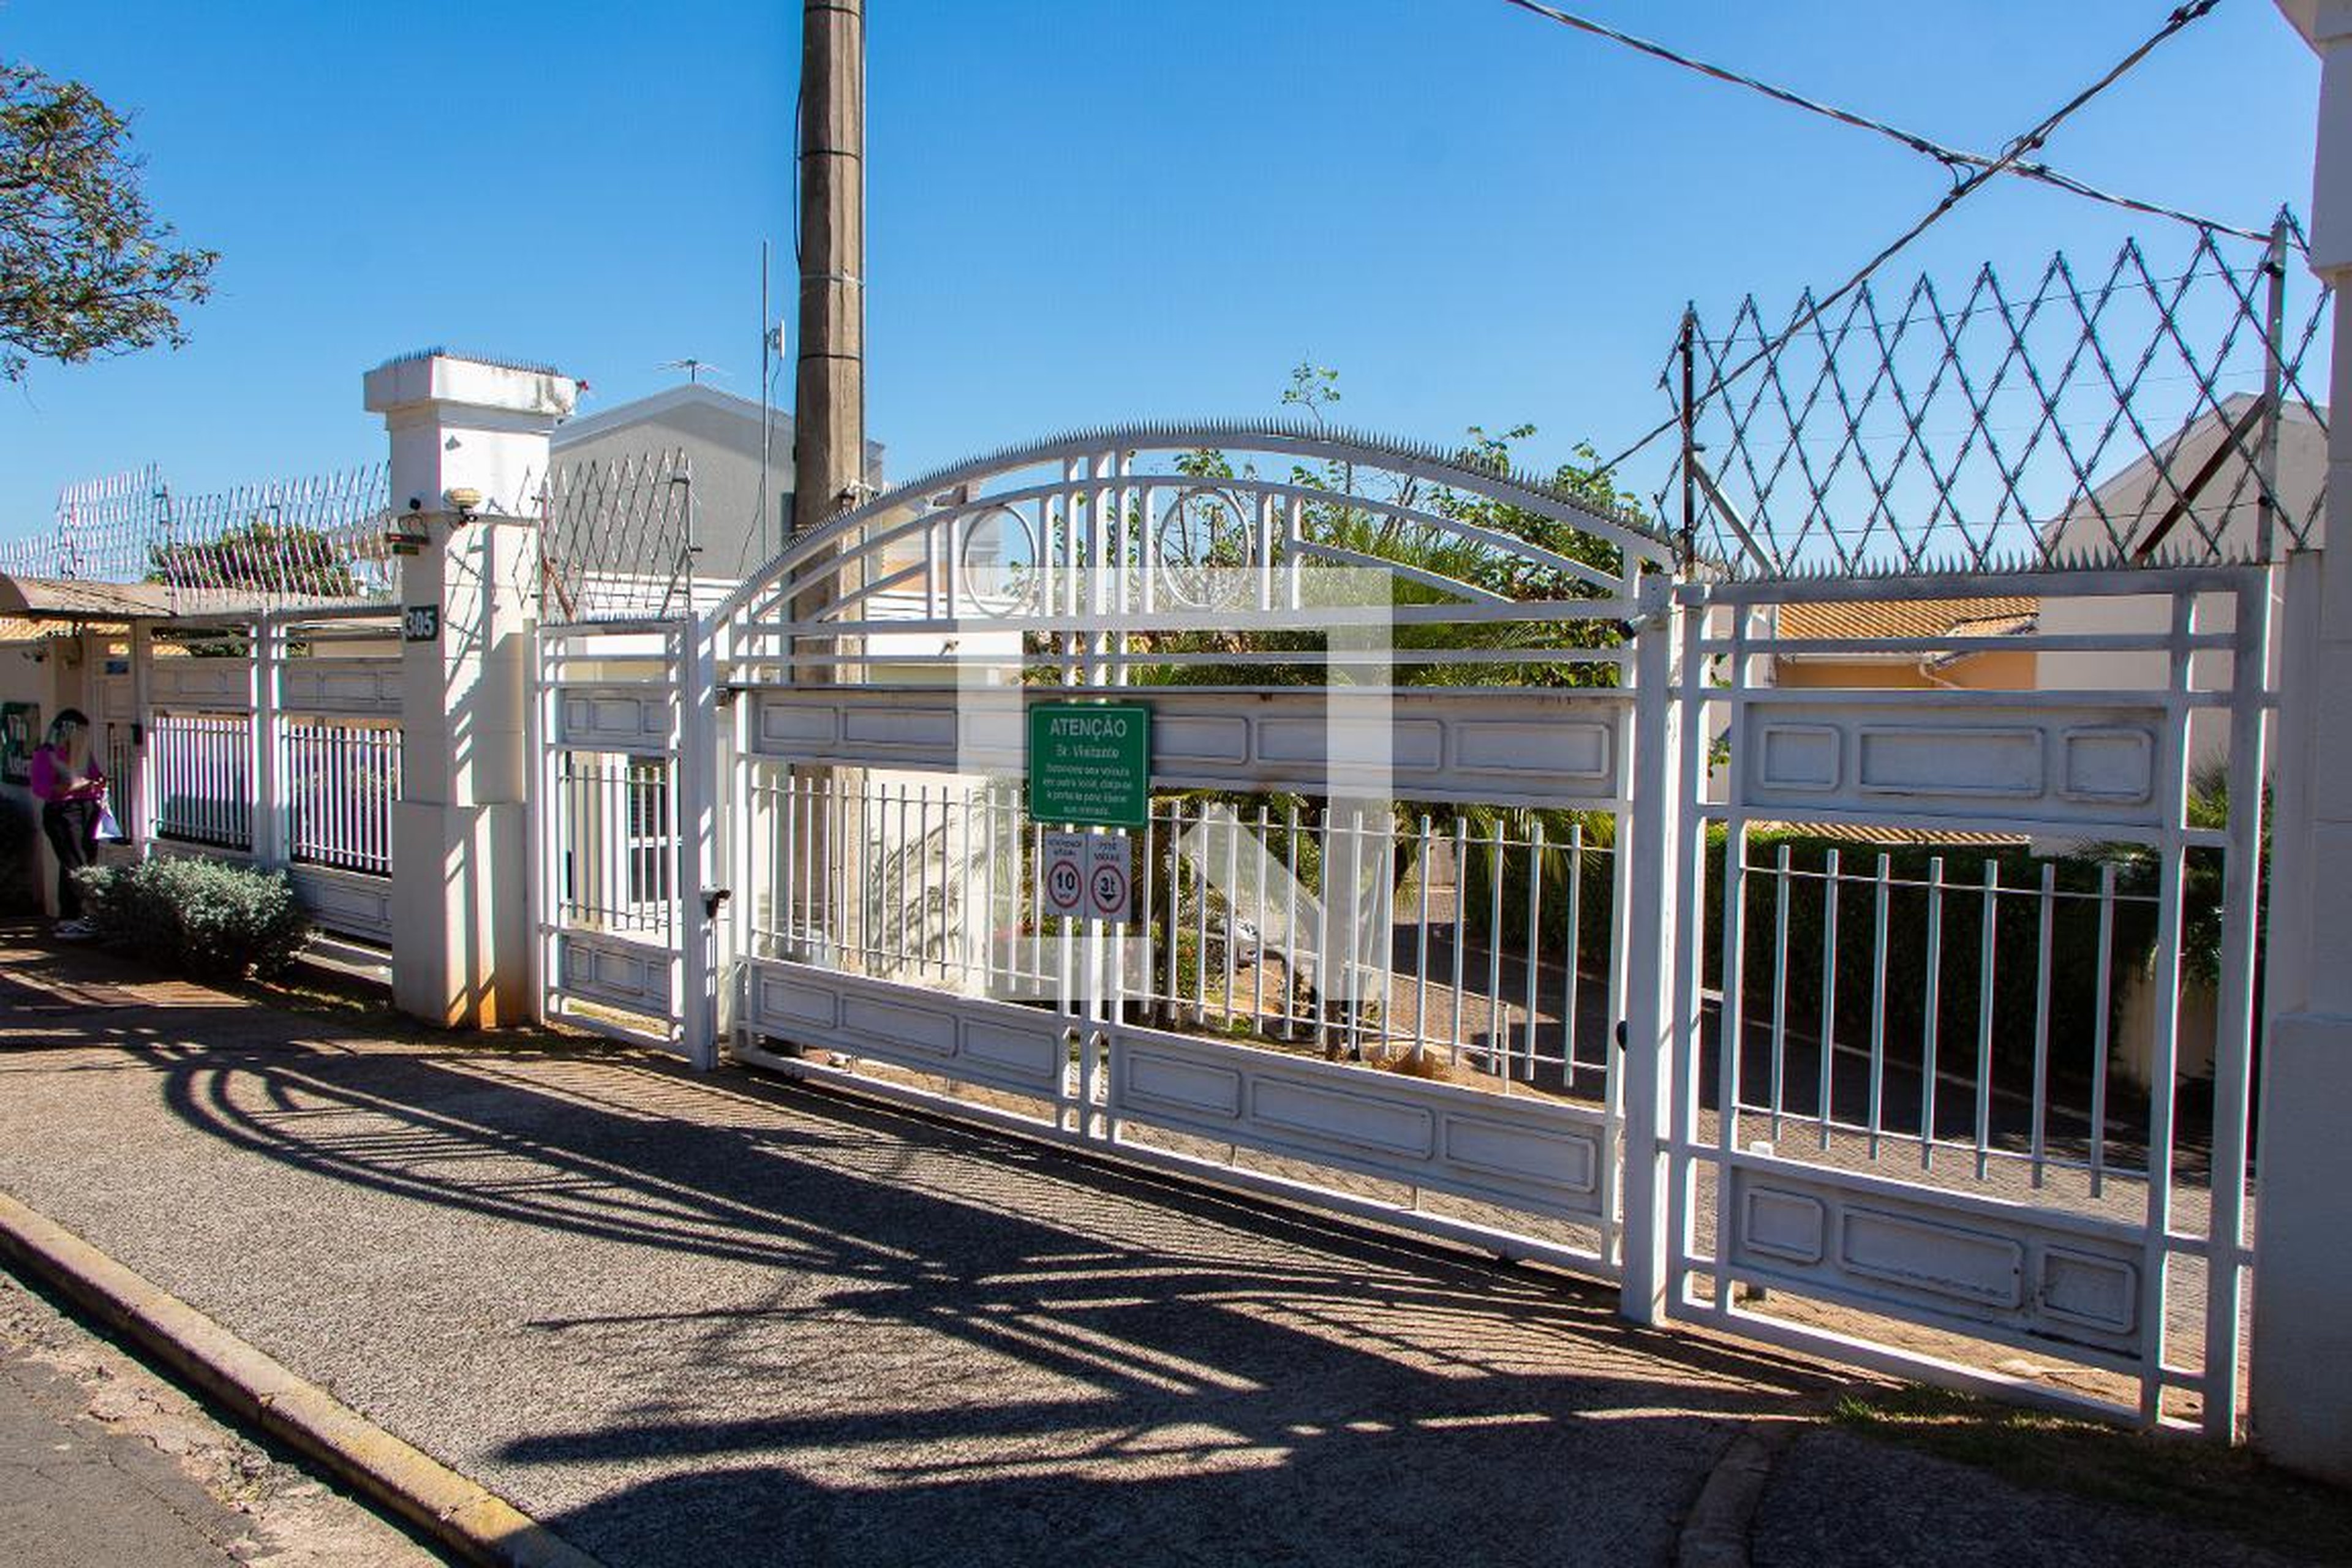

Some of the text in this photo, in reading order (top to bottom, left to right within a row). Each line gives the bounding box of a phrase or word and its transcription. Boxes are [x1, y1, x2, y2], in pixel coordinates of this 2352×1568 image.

[406, 611, 434, 638] 305
[1049, 714, 1127, 741] ATENÇÃO
[1057, 871, 1076, 890] 10
